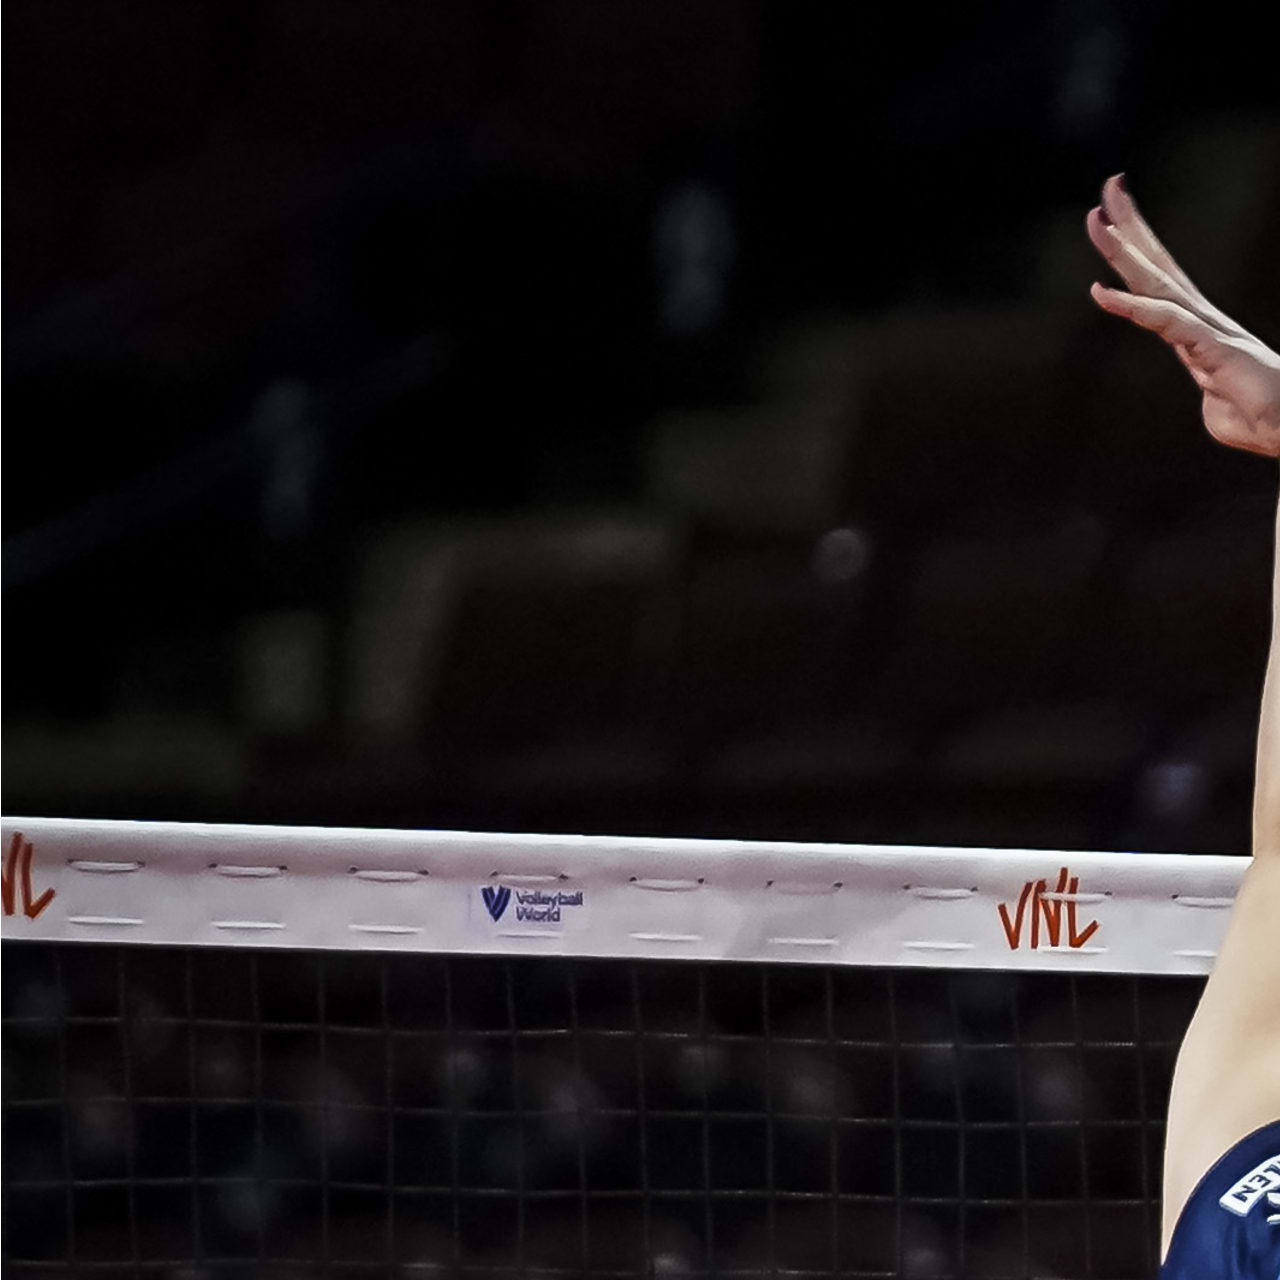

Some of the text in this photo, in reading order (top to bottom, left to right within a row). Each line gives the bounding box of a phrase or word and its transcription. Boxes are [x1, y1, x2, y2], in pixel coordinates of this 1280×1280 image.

[0, 831, 56, 919] NL
[515, 890, 583, 909] Volleyball
[515, 906, 560, 922] World
[998, 867, 1099, 949] VNL
